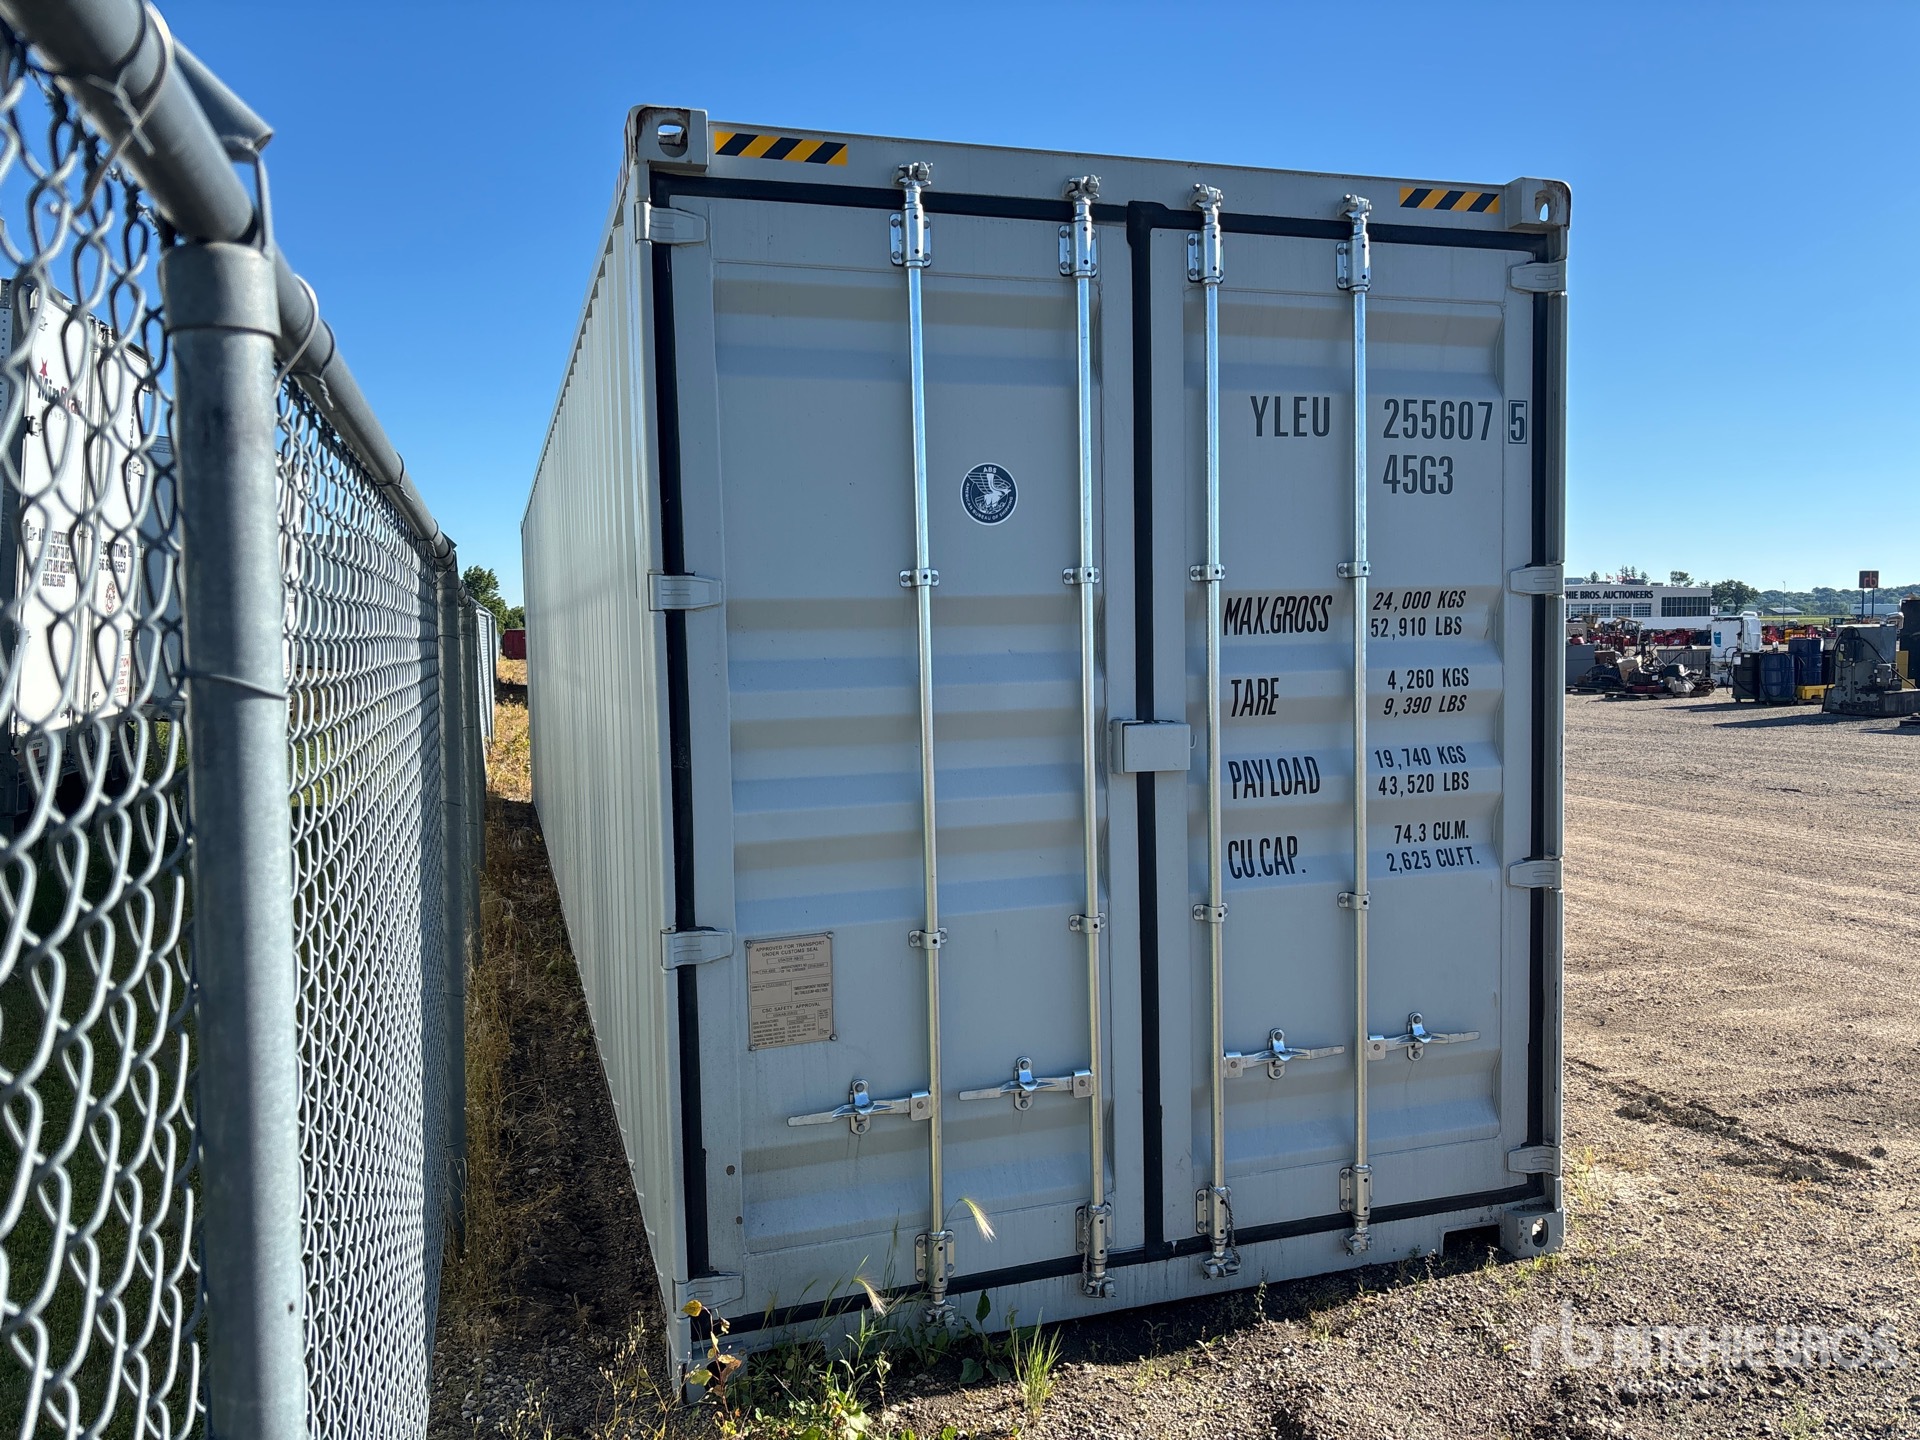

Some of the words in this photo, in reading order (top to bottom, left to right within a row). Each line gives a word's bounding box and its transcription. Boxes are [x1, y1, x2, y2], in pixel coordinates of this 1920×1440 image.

[1250, 396, 1331, 437] YLEU
[1382, 398, 1493, 441] 255607
[1510, 402, 1525, 442] 5
[1383, 454, 1454, 495] 45G3
[1565, 590, 1579, 600] HIE
[1579, 590, 1602, 600] BROS.
[1602, 590, 1654, 599] AUCTIONEERS
[1863, 572, 1877, 588] rb
[1223, 594, 1333, 637] MAX.GROSS
[1372, 591, 1432, 613] 24,000
[1436, 590, 1467, 609] KGS
[1370, 616, 1427, 641] 52,910
[1434, 616, 1463, 636] LBS
[1230, 677, 1280, 718] TARE
[1387, 668, 1435, 693] 4,260
[1441, 667, 1470, 688] KGS
[1382, 696, 1432, 718] 9,390
[1437, 694, 1468, 713] LBS
[1227, 755, 1321, 800] PAYLOAD
[1373, 747, 1433, 770] 19,740
[1437, 745, 1467, 766] KGS
[1377, 773, 1435, 798] 43,520
[1442, 771, 1470, 792] LBS
[1227, 835, 1307, 880] CU.CAP.
[1393, 823, 1427, 845] 74.3
[1432, 819, 1470, 841] CU.M.
[1385, 851, 1432, 875] 2,625
[1436, 846, 1481, 869] CU.FT.
